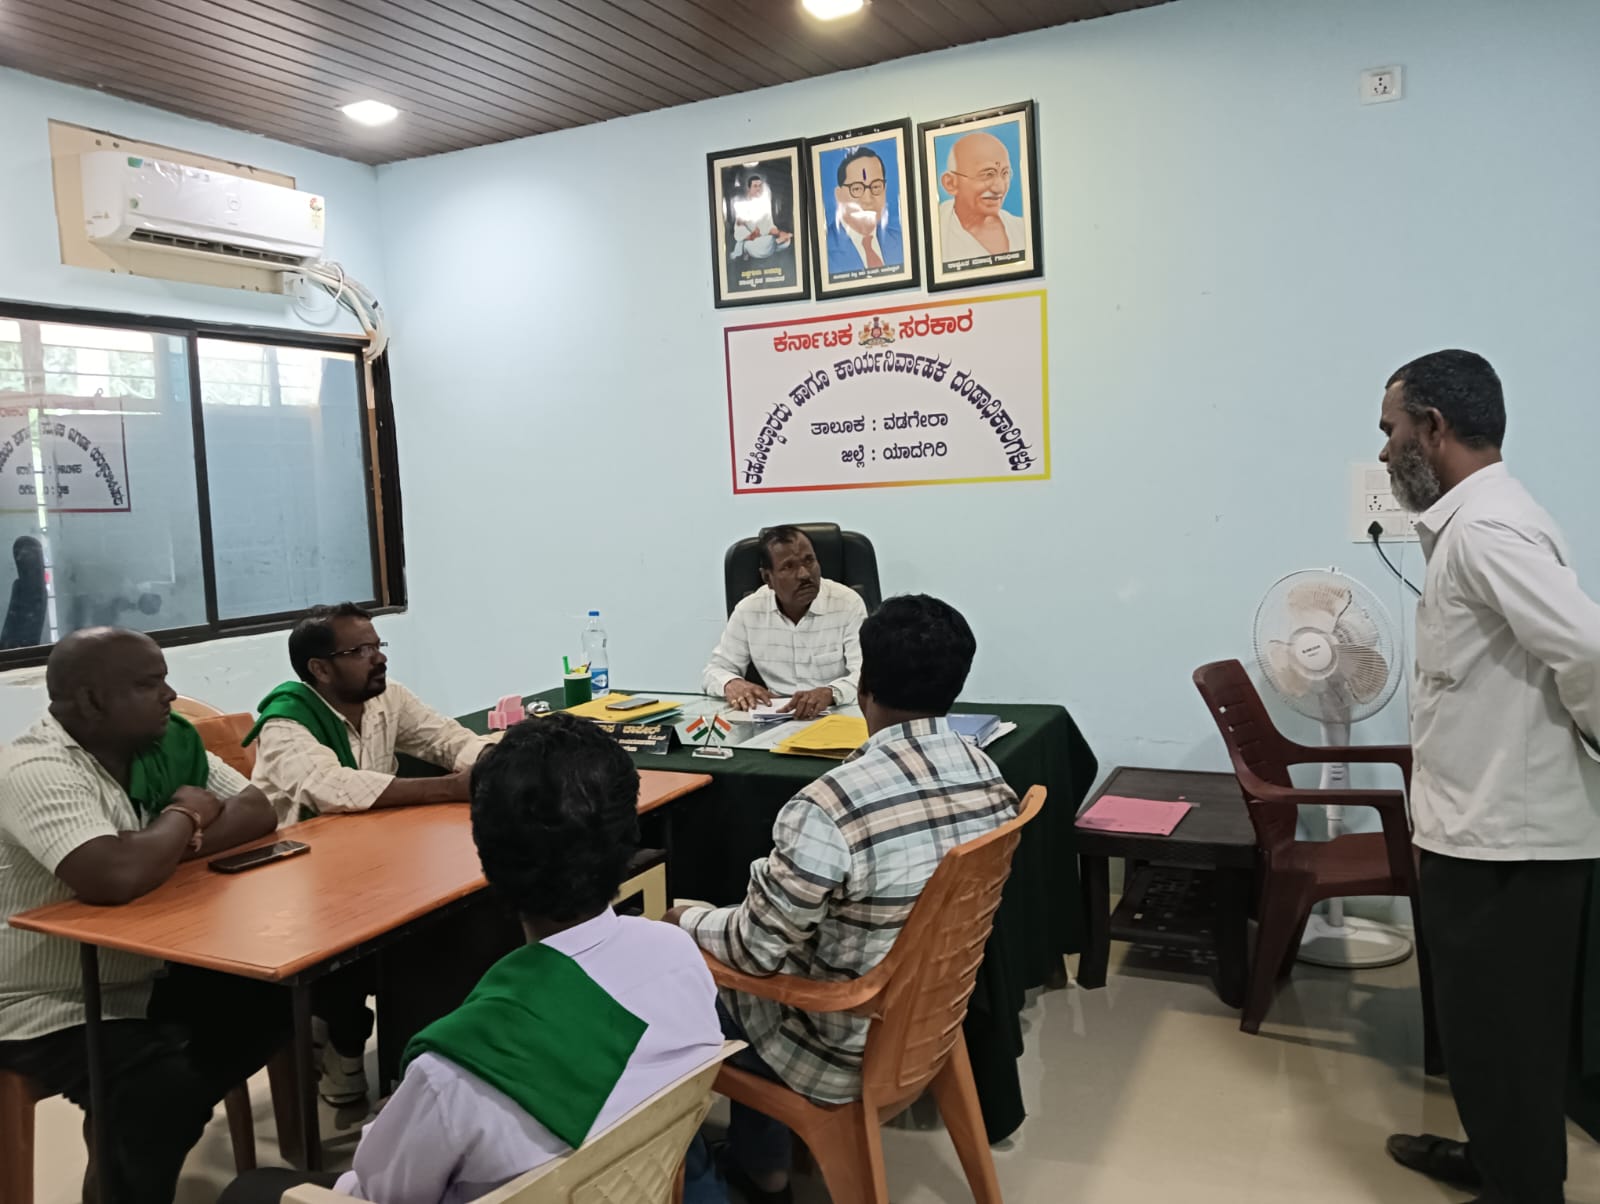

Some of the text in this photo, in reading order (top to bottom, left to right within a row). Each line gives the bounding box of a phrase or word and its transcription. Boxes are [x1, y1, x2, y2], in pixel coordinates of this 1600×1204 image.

[773, 308, 974, 352] ಕರ್ನಾಟಕ ಸರಕಾರ
[788, 368, 831, 407] ಹಾಗೂ
[833, 350, 953, 382] ಕಾರ್ಯನಿರ್ವಾಹಕ
[950, 368, 1038, 471] ದಂಡಾಧಿಕಾರಿಗಳು
[811, 415, 865, 435] ತಾಲೂಕ
[883, 410, 949, 430] ವಡಗೇರಾ
[841, 444, 865, 468] ಜಿಲ್ಲೆ
[883, 441, 948, 460] ಯಾದಗಿರಿ
